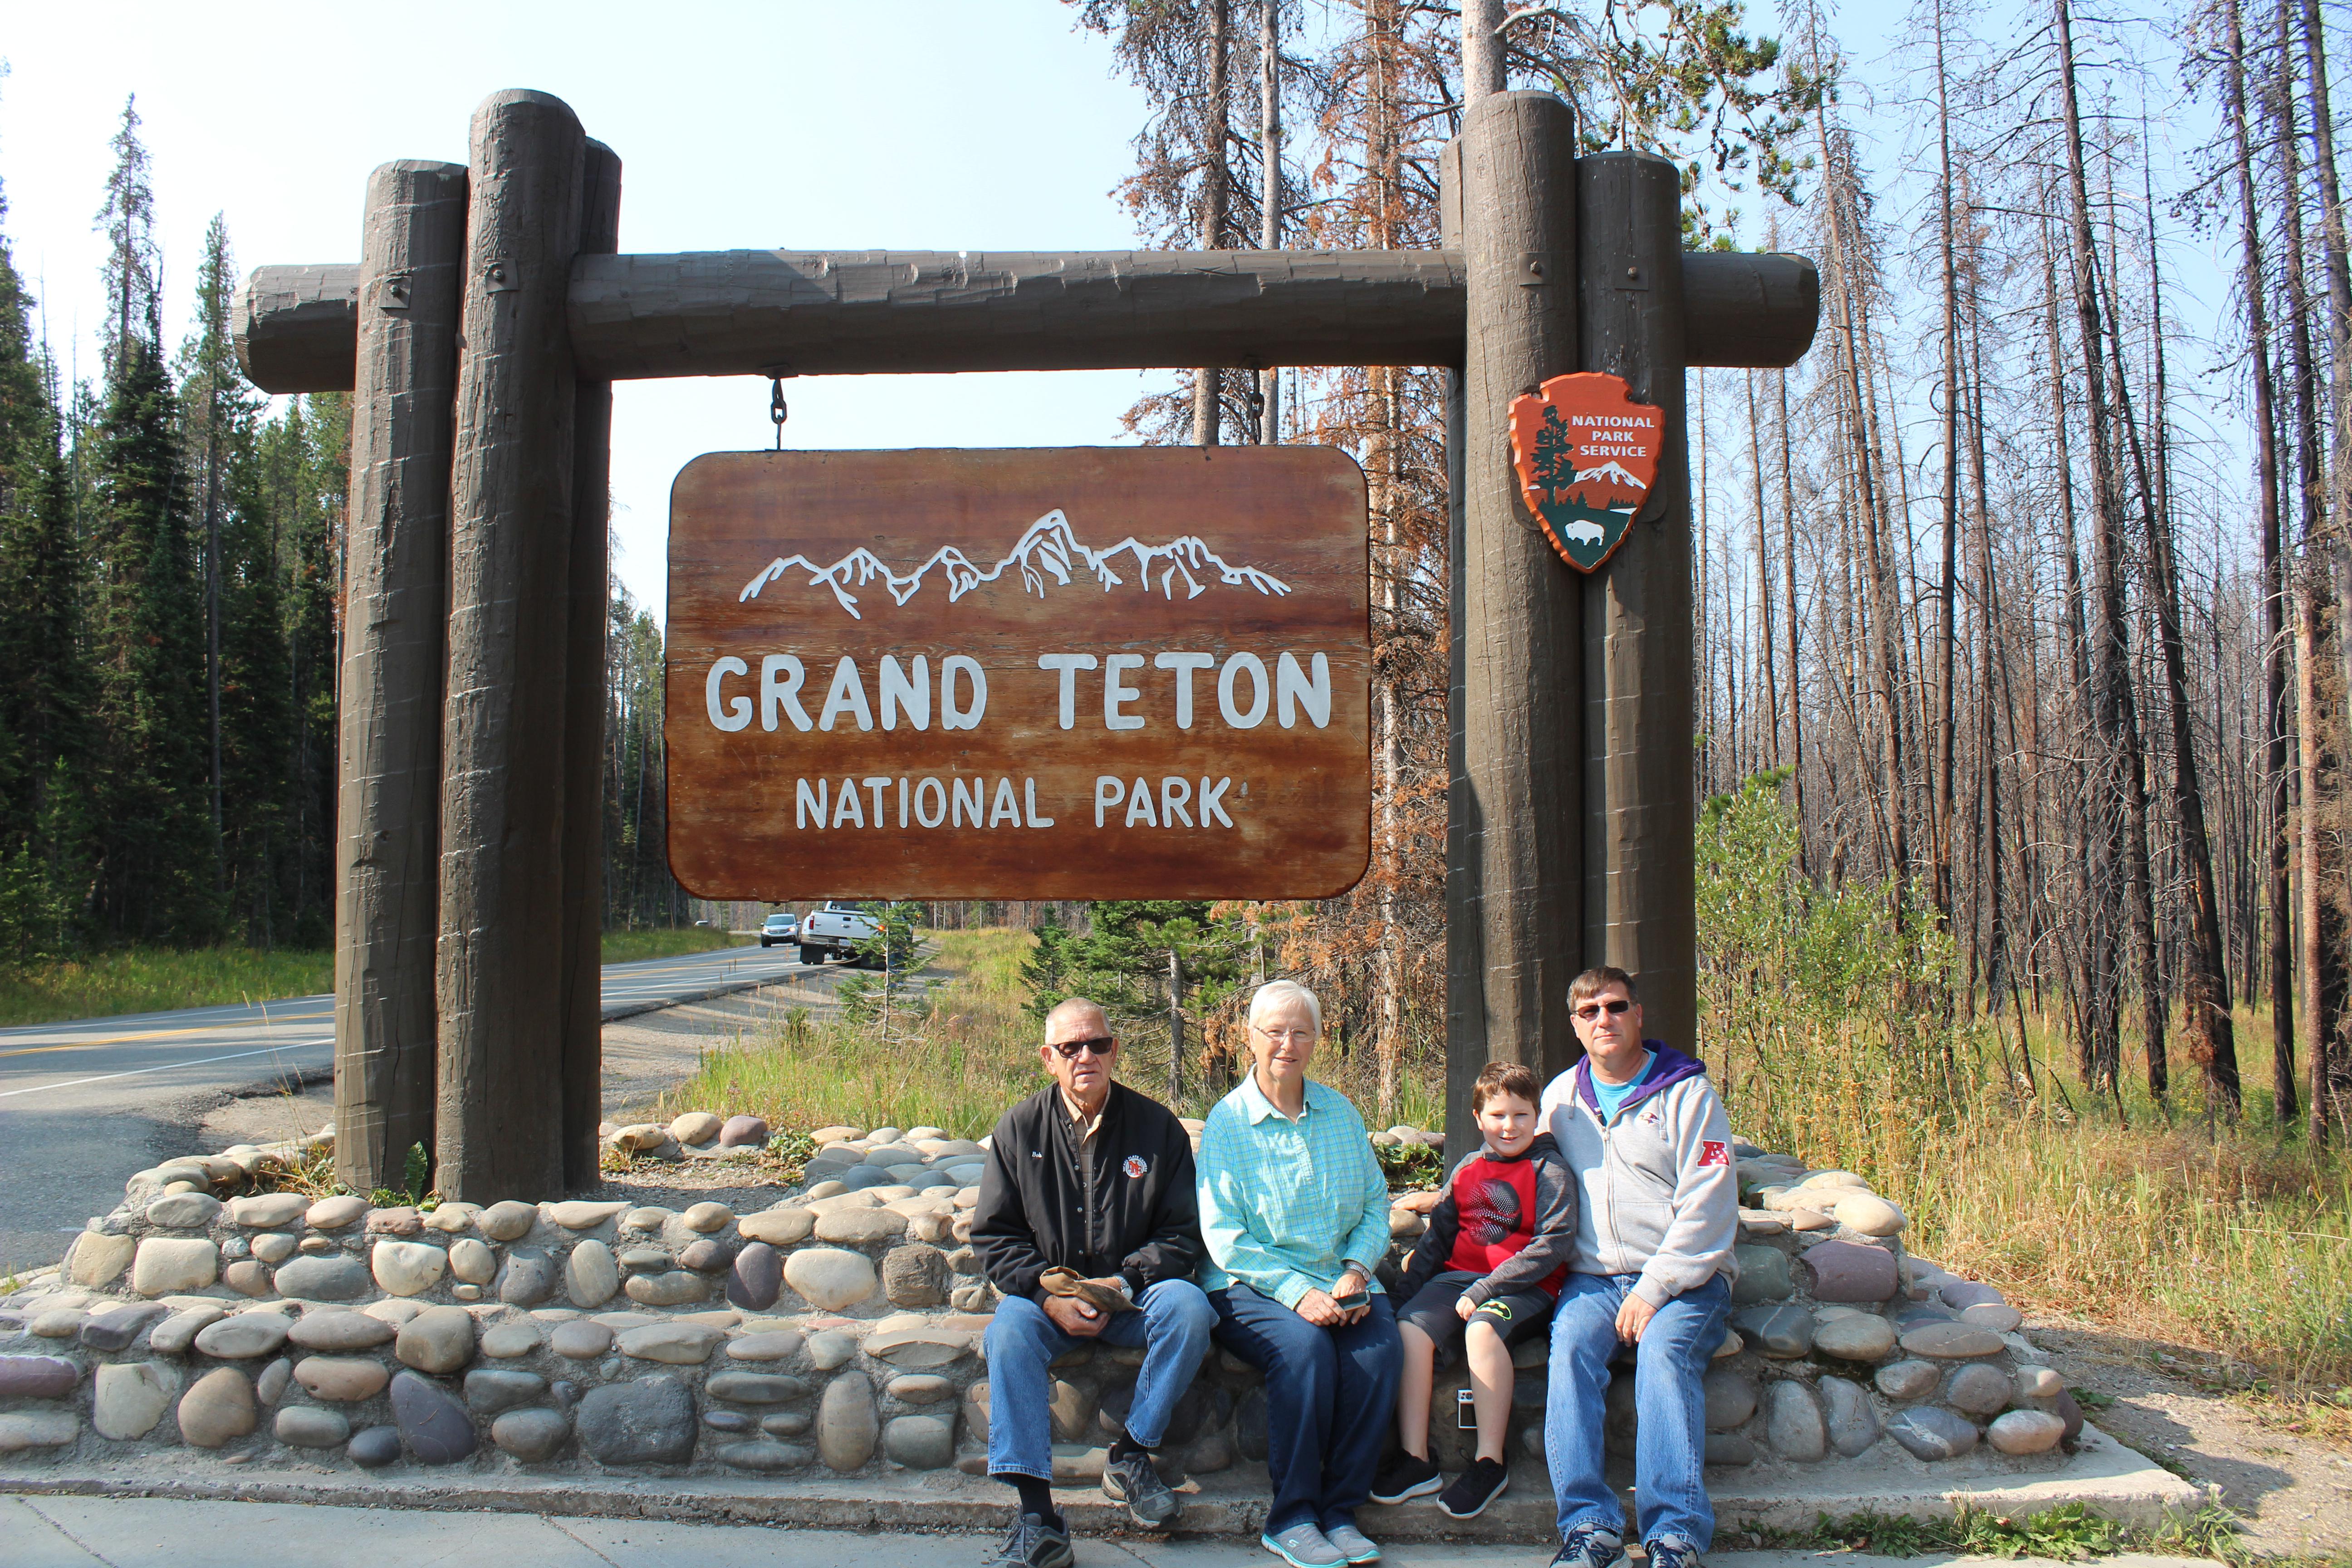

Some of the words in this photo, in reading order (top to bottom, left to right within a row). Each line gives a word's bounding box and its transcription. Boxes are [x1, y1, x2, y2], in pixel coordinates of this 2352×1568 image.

[1572, 416, 1655, 428] NATIONAL
[1592, 431, 1634, 442] PARK
[1580, 445, 1647, 457] SERVICE
[706, 654, 988, 732] GRAND
[1037, 651, 1332, 730] TETON
[796, 776, 1055, 830] NATIONAL
[1095, 775, 1234, 828] PARK
[1696, 1139, 1730, 1168] A
